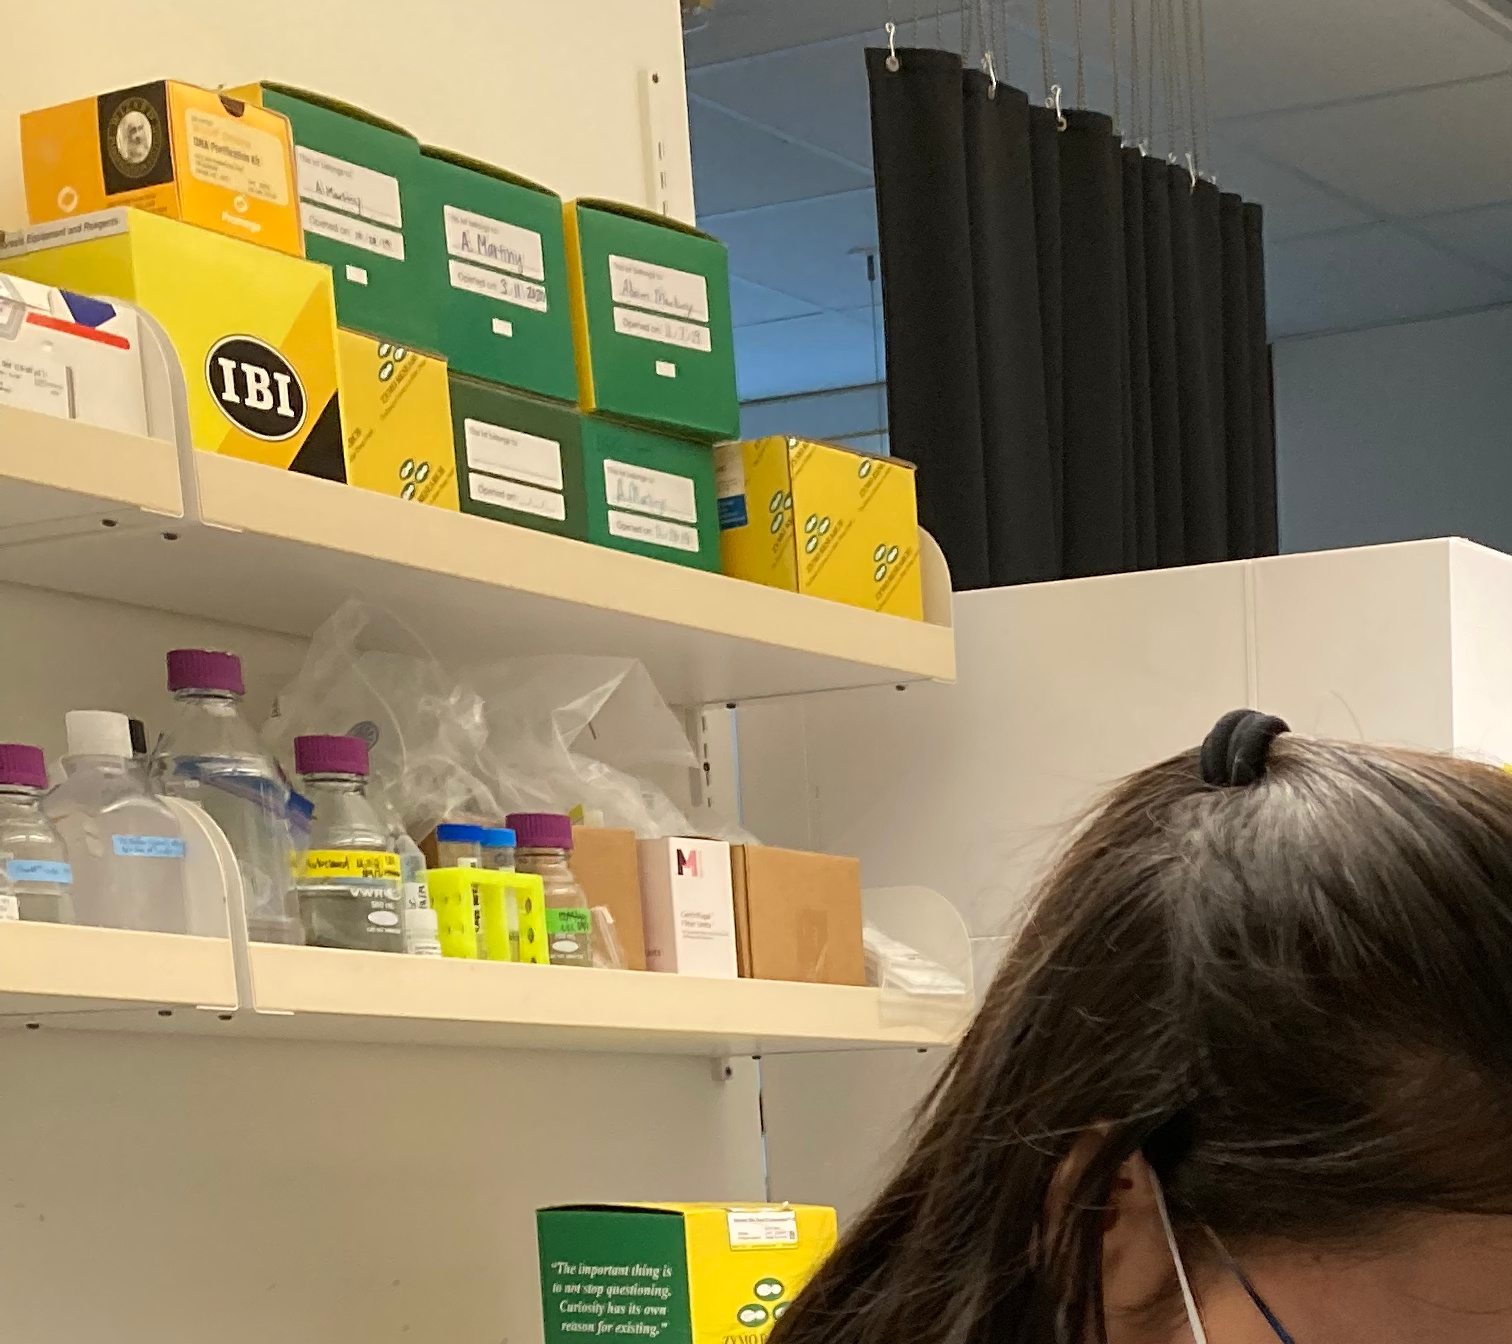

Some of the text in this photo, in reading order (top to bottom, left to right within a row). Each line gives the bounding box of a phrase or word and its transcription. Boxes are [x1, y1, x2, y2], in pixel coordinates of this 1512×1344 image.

[217, 356, 295, 418] IBI
[578, 1263, 629, 1280] important
[631, 1264, 660, 1280] thing
[662, 1264, 673, 1279] is
[552, 1282, 672, 1299] to not stop questioning.
[559, 1300, 667, 1317] Curiosity has its own
[561, 1321, 595, 1333] reason
[596, 1320, 614, 1336] for
